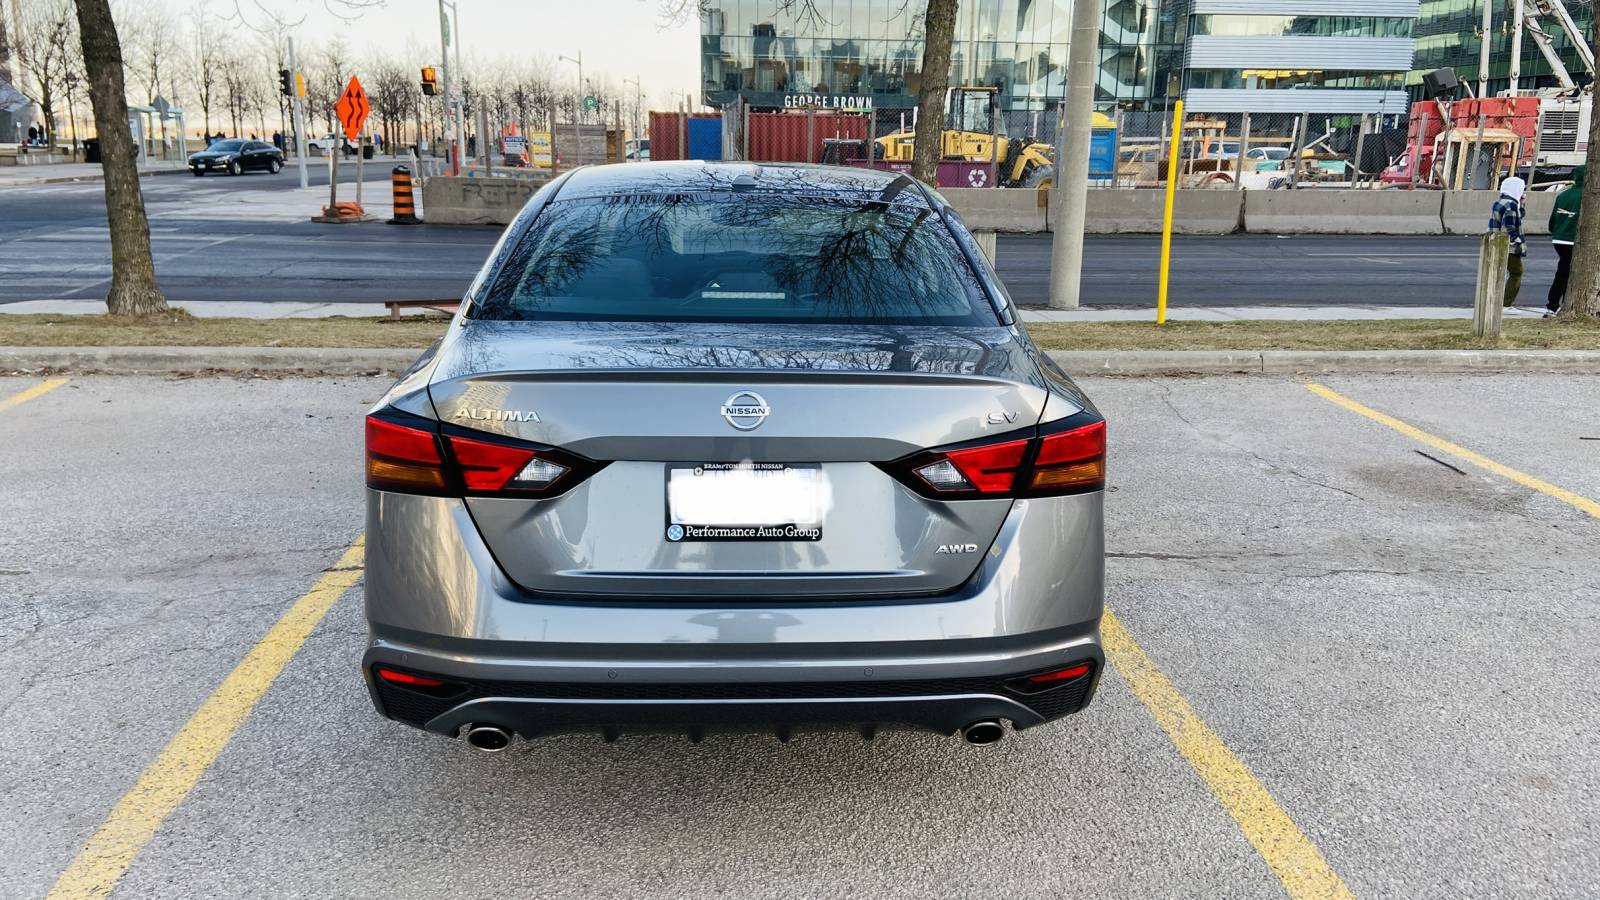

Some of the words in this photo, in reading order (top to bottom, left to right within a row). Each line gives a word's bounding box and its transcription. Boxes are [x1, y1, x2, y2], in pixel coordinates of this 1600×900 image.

[784, 95, 828, 109] GEORGE
[833, 96, 873, 109] BROWN
[454, 408, 542, 423] ALTIMA
[726, 407, 766, 415] NISSAN
[987, 411, 1020, 424] SV
[686, 526, 756, 537] Performance
[757, 526, 784, 537] Auto
[785, 526, 820, 540] Group
[936, 543, 978, 554] AWD
